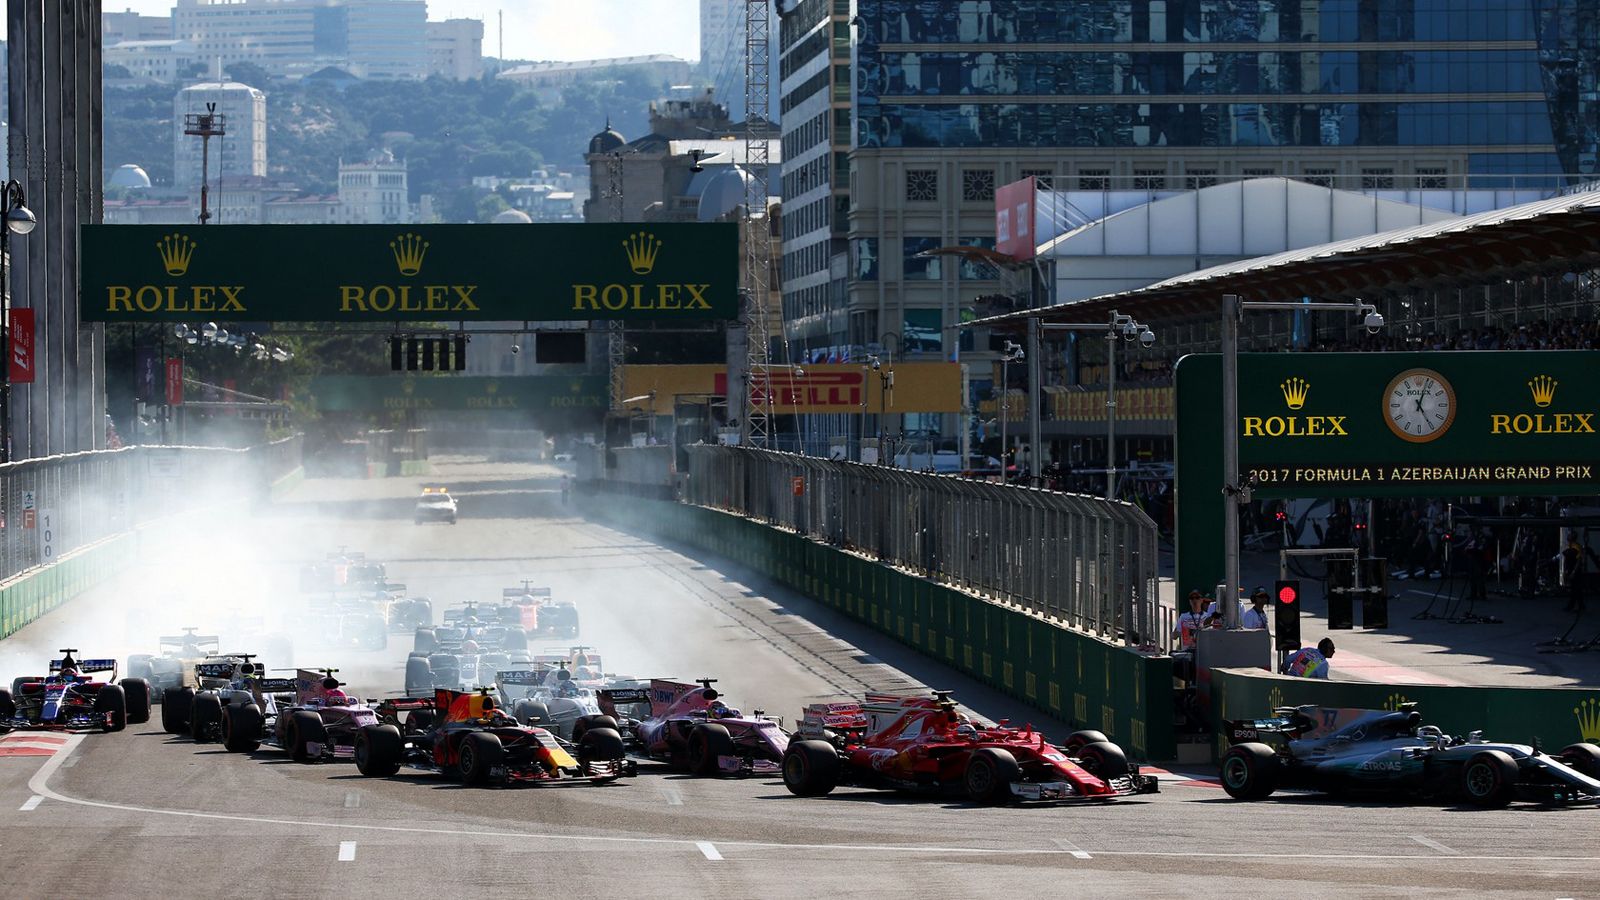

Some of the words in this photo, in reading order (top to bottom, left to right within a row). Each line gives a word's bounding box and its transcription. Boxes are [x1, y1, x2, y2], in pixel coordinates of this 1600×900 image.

[106, 286, 247, 312] ROLEX
[339, 285, 480, 311] ROLEX
[572, 284, 712, 310] ROLEX
[1243, 416, 1348, 436] ROLEX
[1490, 413, 1596, 434] ROLEX
[1249, 469, 1290, 482] 2017
[1295, 468, 1371, 482] FORMULA
[1376, 469, 1385, 481] 1
[1390, 467, 1490, 480] AZERBAIJAN
[1494, 466, 1551, 480] GRAND
[1555, 465, 1592, 479] PRIX
[1234, 729, 1257, 739] EPSON
